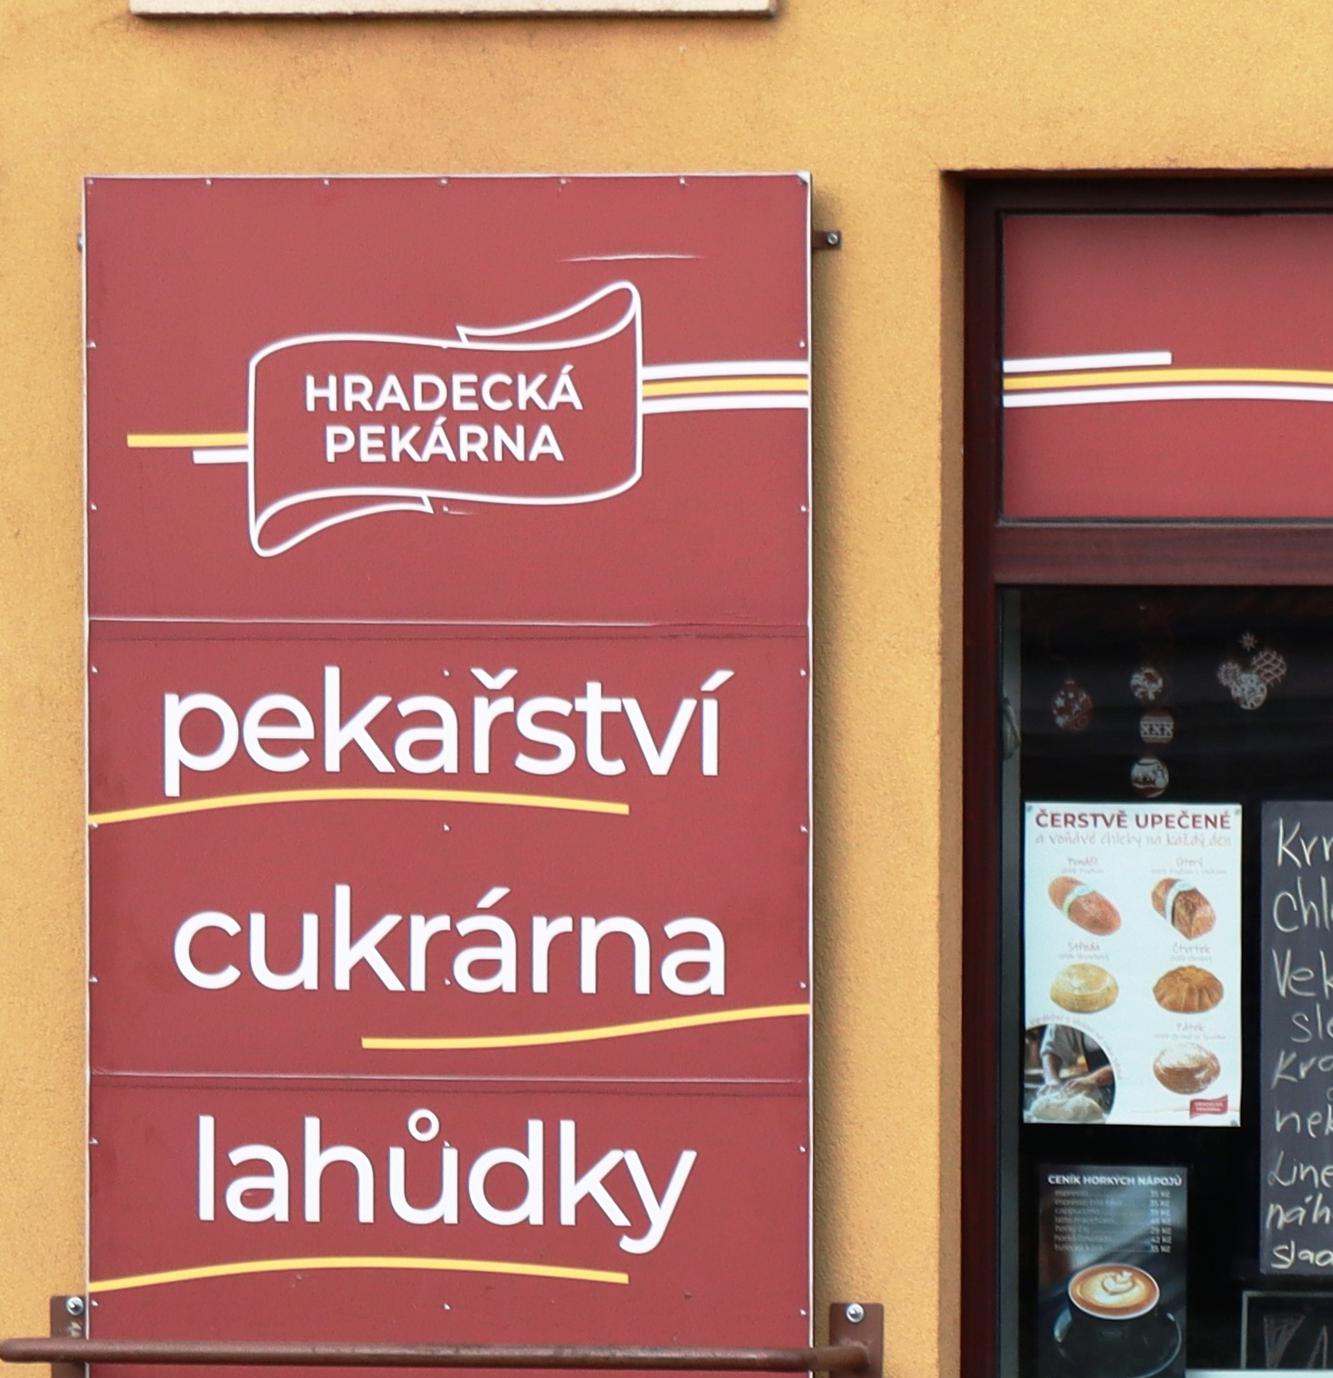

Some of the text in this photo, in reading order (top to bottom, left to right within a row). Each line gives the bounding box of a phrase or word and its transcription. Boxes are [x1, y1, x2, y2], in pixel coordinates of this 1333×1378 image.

[304, 365, 584, 413] HRADECKÁ
[324, 423, 565, 464] PEKÁRNA
[163, 665, 735, 797] pekařství
[1034, 809, 1231, 830] ČERSTVĚ UPEČENÉ
[172, 884, 726, 996] cukrárna
[197, 1109, 698, 1254] lahůdky
[1047, 1174, 1182, 1187] CENÍK HORKÝCH NÁPOJŮ
